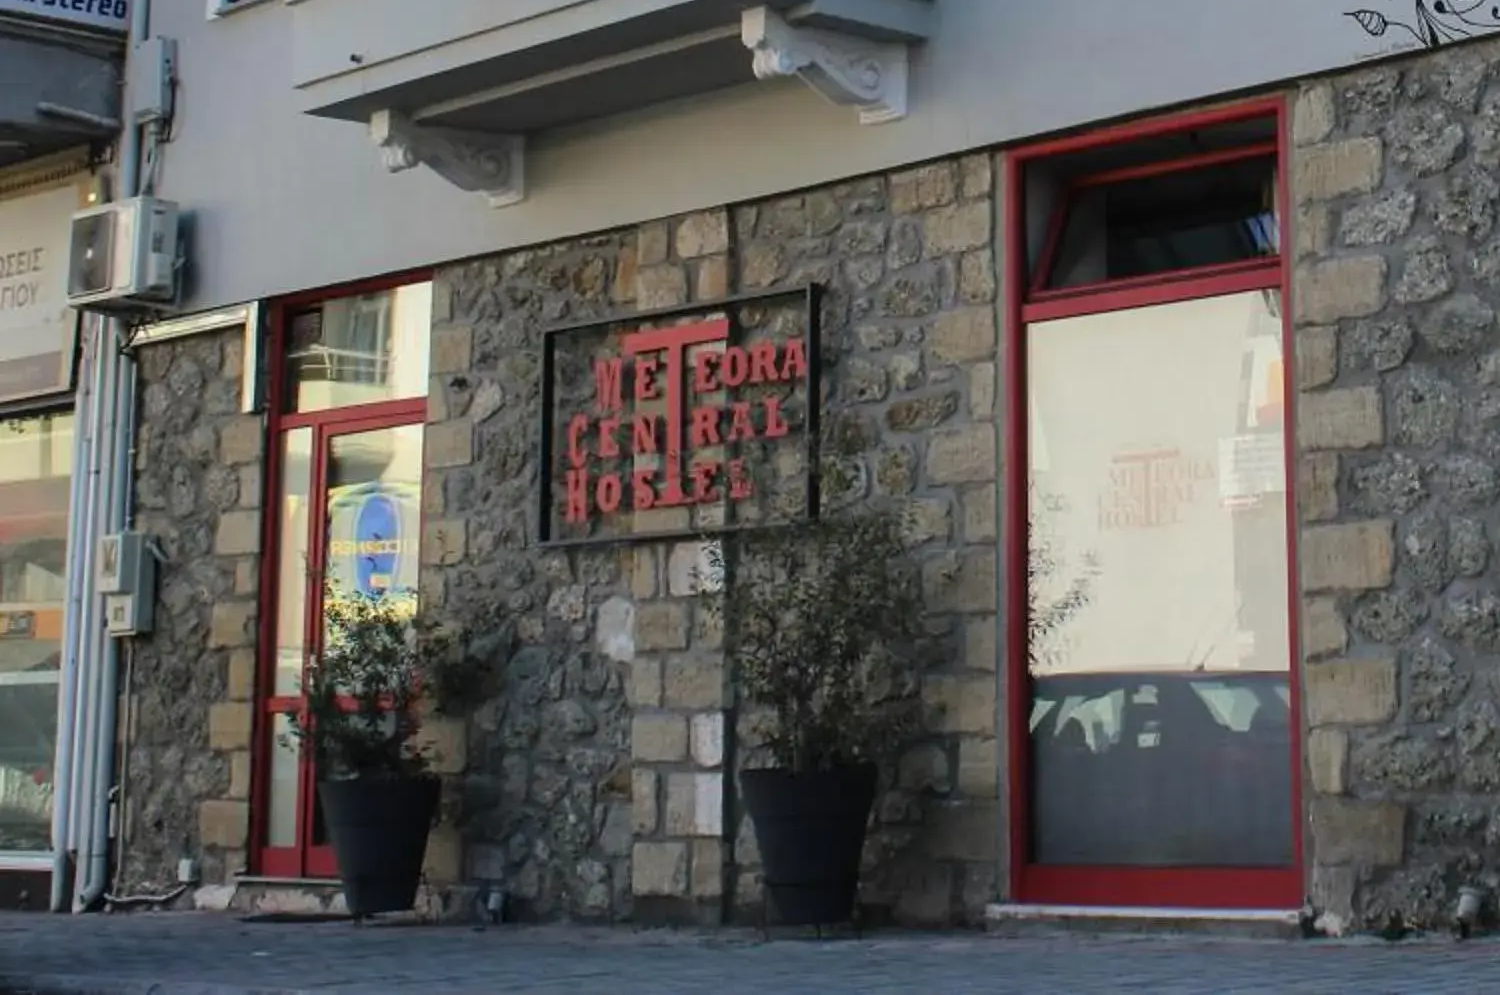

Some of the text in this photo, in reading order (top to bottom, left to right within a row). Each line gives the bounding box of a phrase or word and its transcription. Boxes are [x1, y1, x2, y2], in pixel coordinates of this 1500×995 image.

[595, 319, 806, 411] METEORA
[569, 395, 790, 468] CENTRAL
[565, 457, 758, 523] HOSTEL
